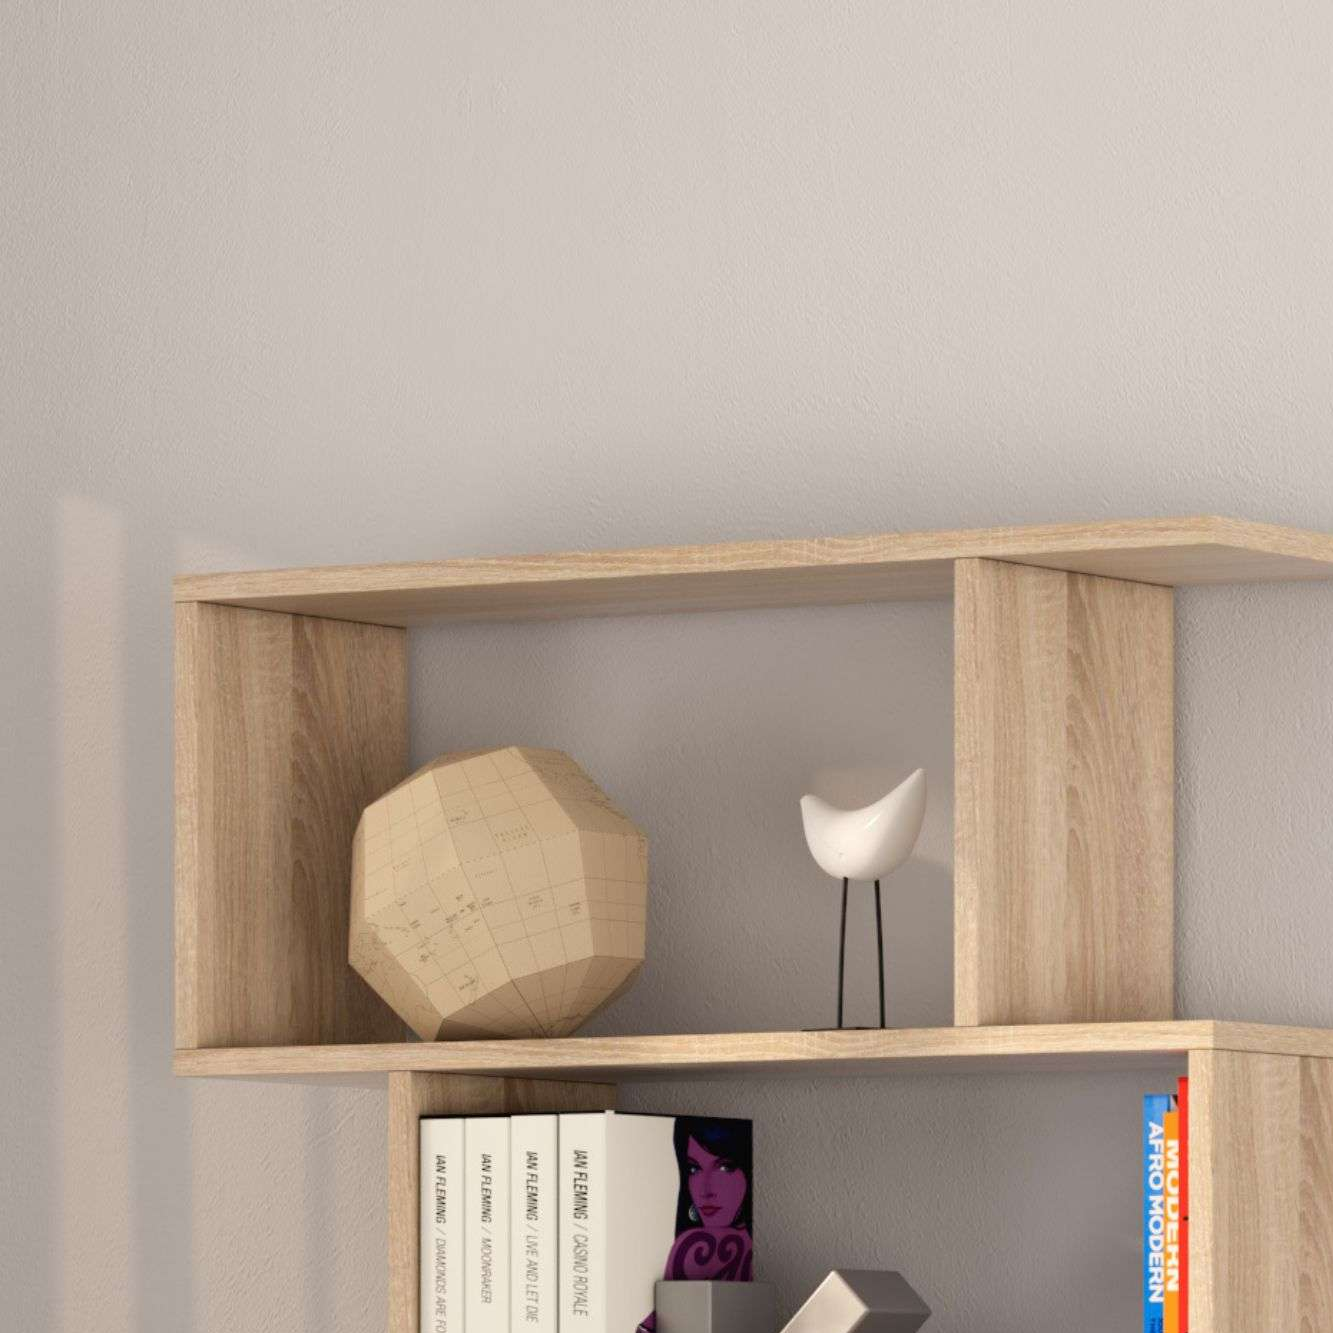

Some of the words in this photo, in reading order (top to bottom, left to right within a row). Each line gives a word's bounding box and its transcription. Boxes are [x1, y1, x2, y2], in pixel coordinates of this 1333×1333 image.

[1148, 1121, 1164, 1191] AFRO
[435, 1176, 447, 1224] FLEMING
[481, 1175, 493, 1223] FLEMING
[526, 1173, 539, 1221] FLEMING
[573, 1171, 589, 1220] FLEMING
[1166, 1138, 1180, 1292] MODERN
[1148, 1196, 1164, 1304] MODERN
